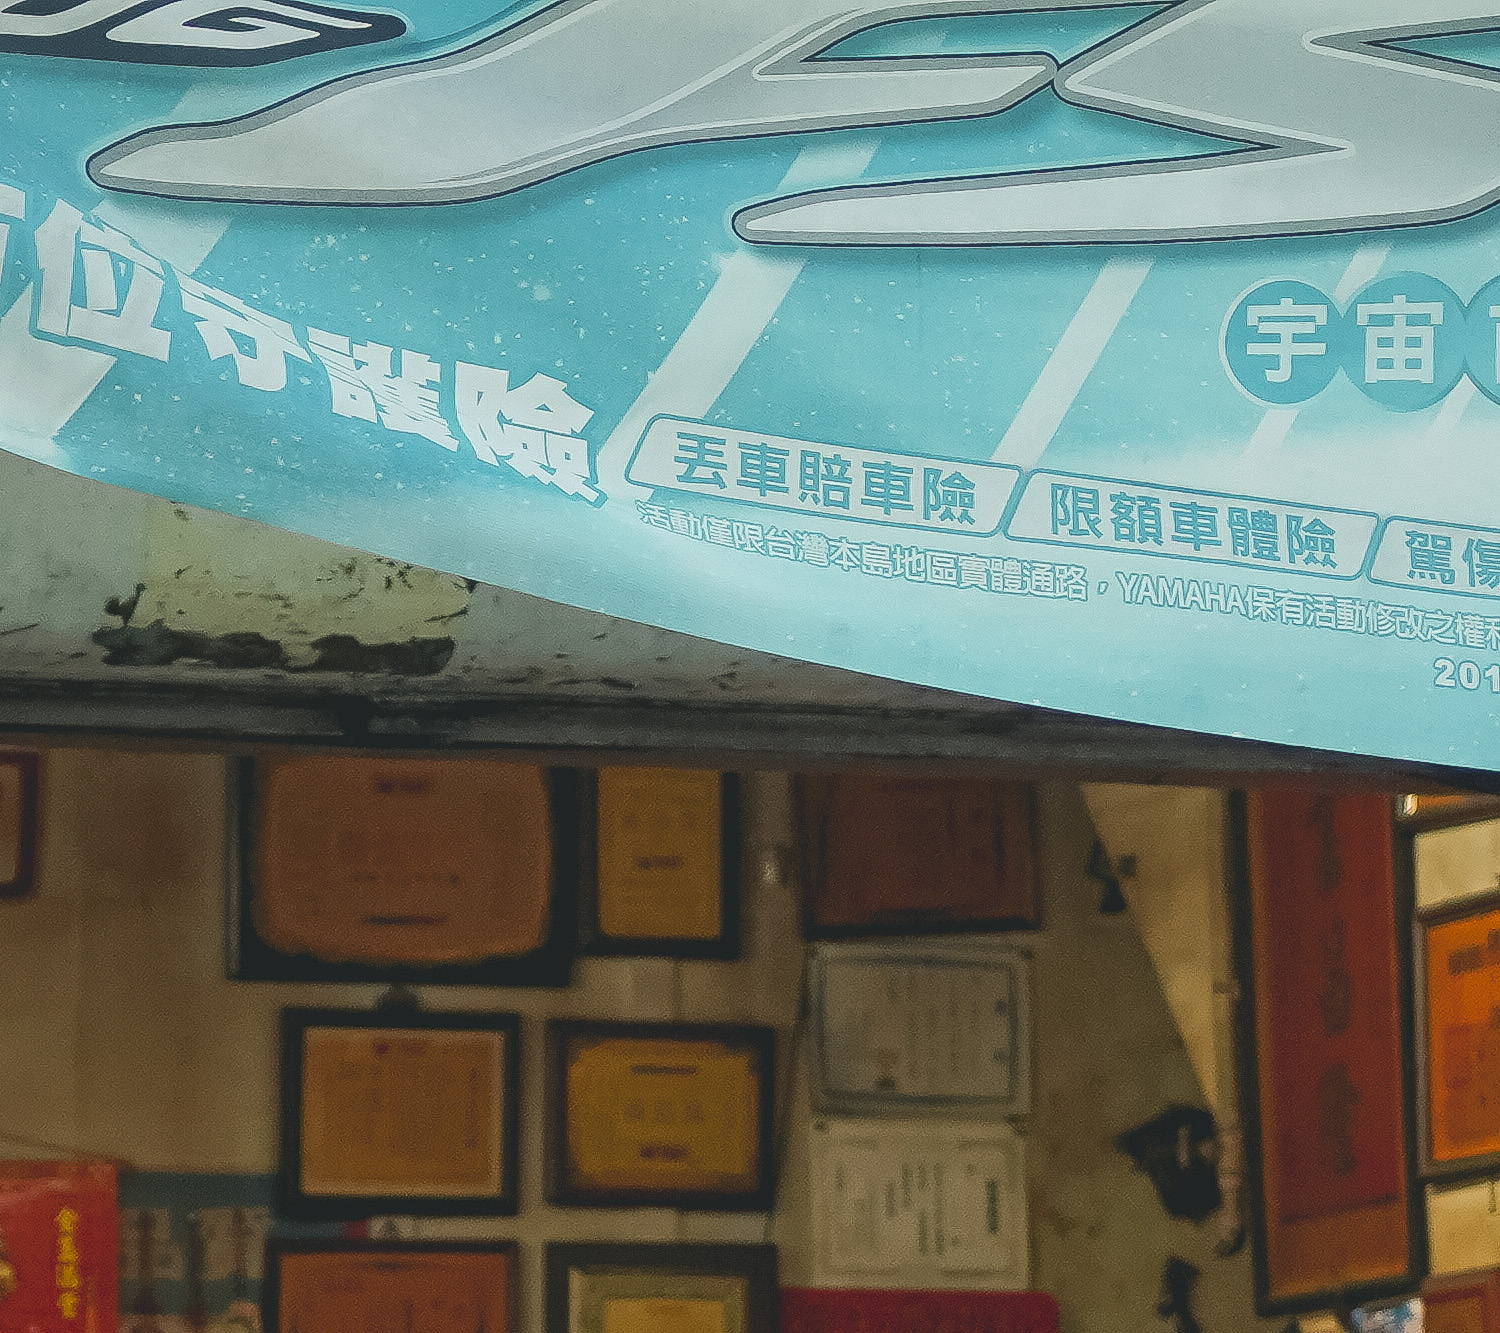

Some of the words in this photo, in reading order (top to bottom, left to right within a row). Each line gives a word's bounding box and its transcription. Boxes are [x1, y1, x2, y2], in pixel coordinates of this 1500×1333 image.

[673, 431, 978, 527] 丟車賠車險
[1049, 481, 1339, 571] 限額車體險
